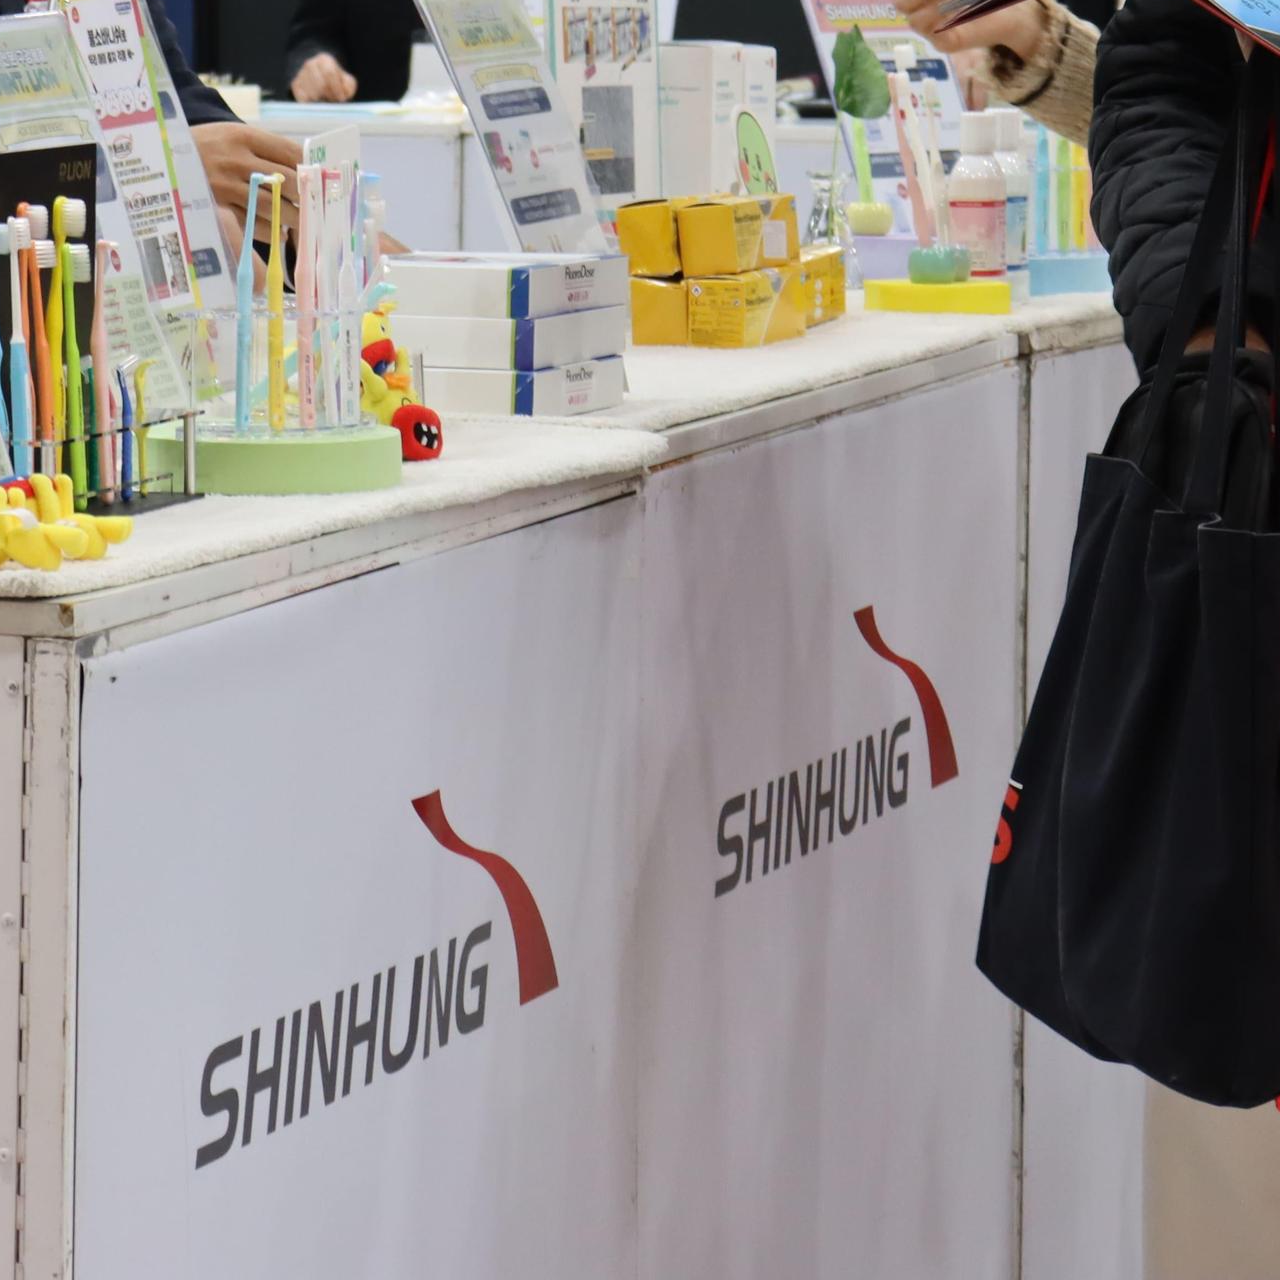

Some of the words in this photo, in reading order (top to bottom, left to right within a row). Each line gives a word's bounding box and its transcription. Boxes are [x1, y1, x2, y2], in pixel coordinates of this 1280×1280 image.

[825, 4, 897, 20] SHINHUNG
[715, 717, 911, 898] SHINHUNG
[195, 921, 492, 1171] SHINHUNG
